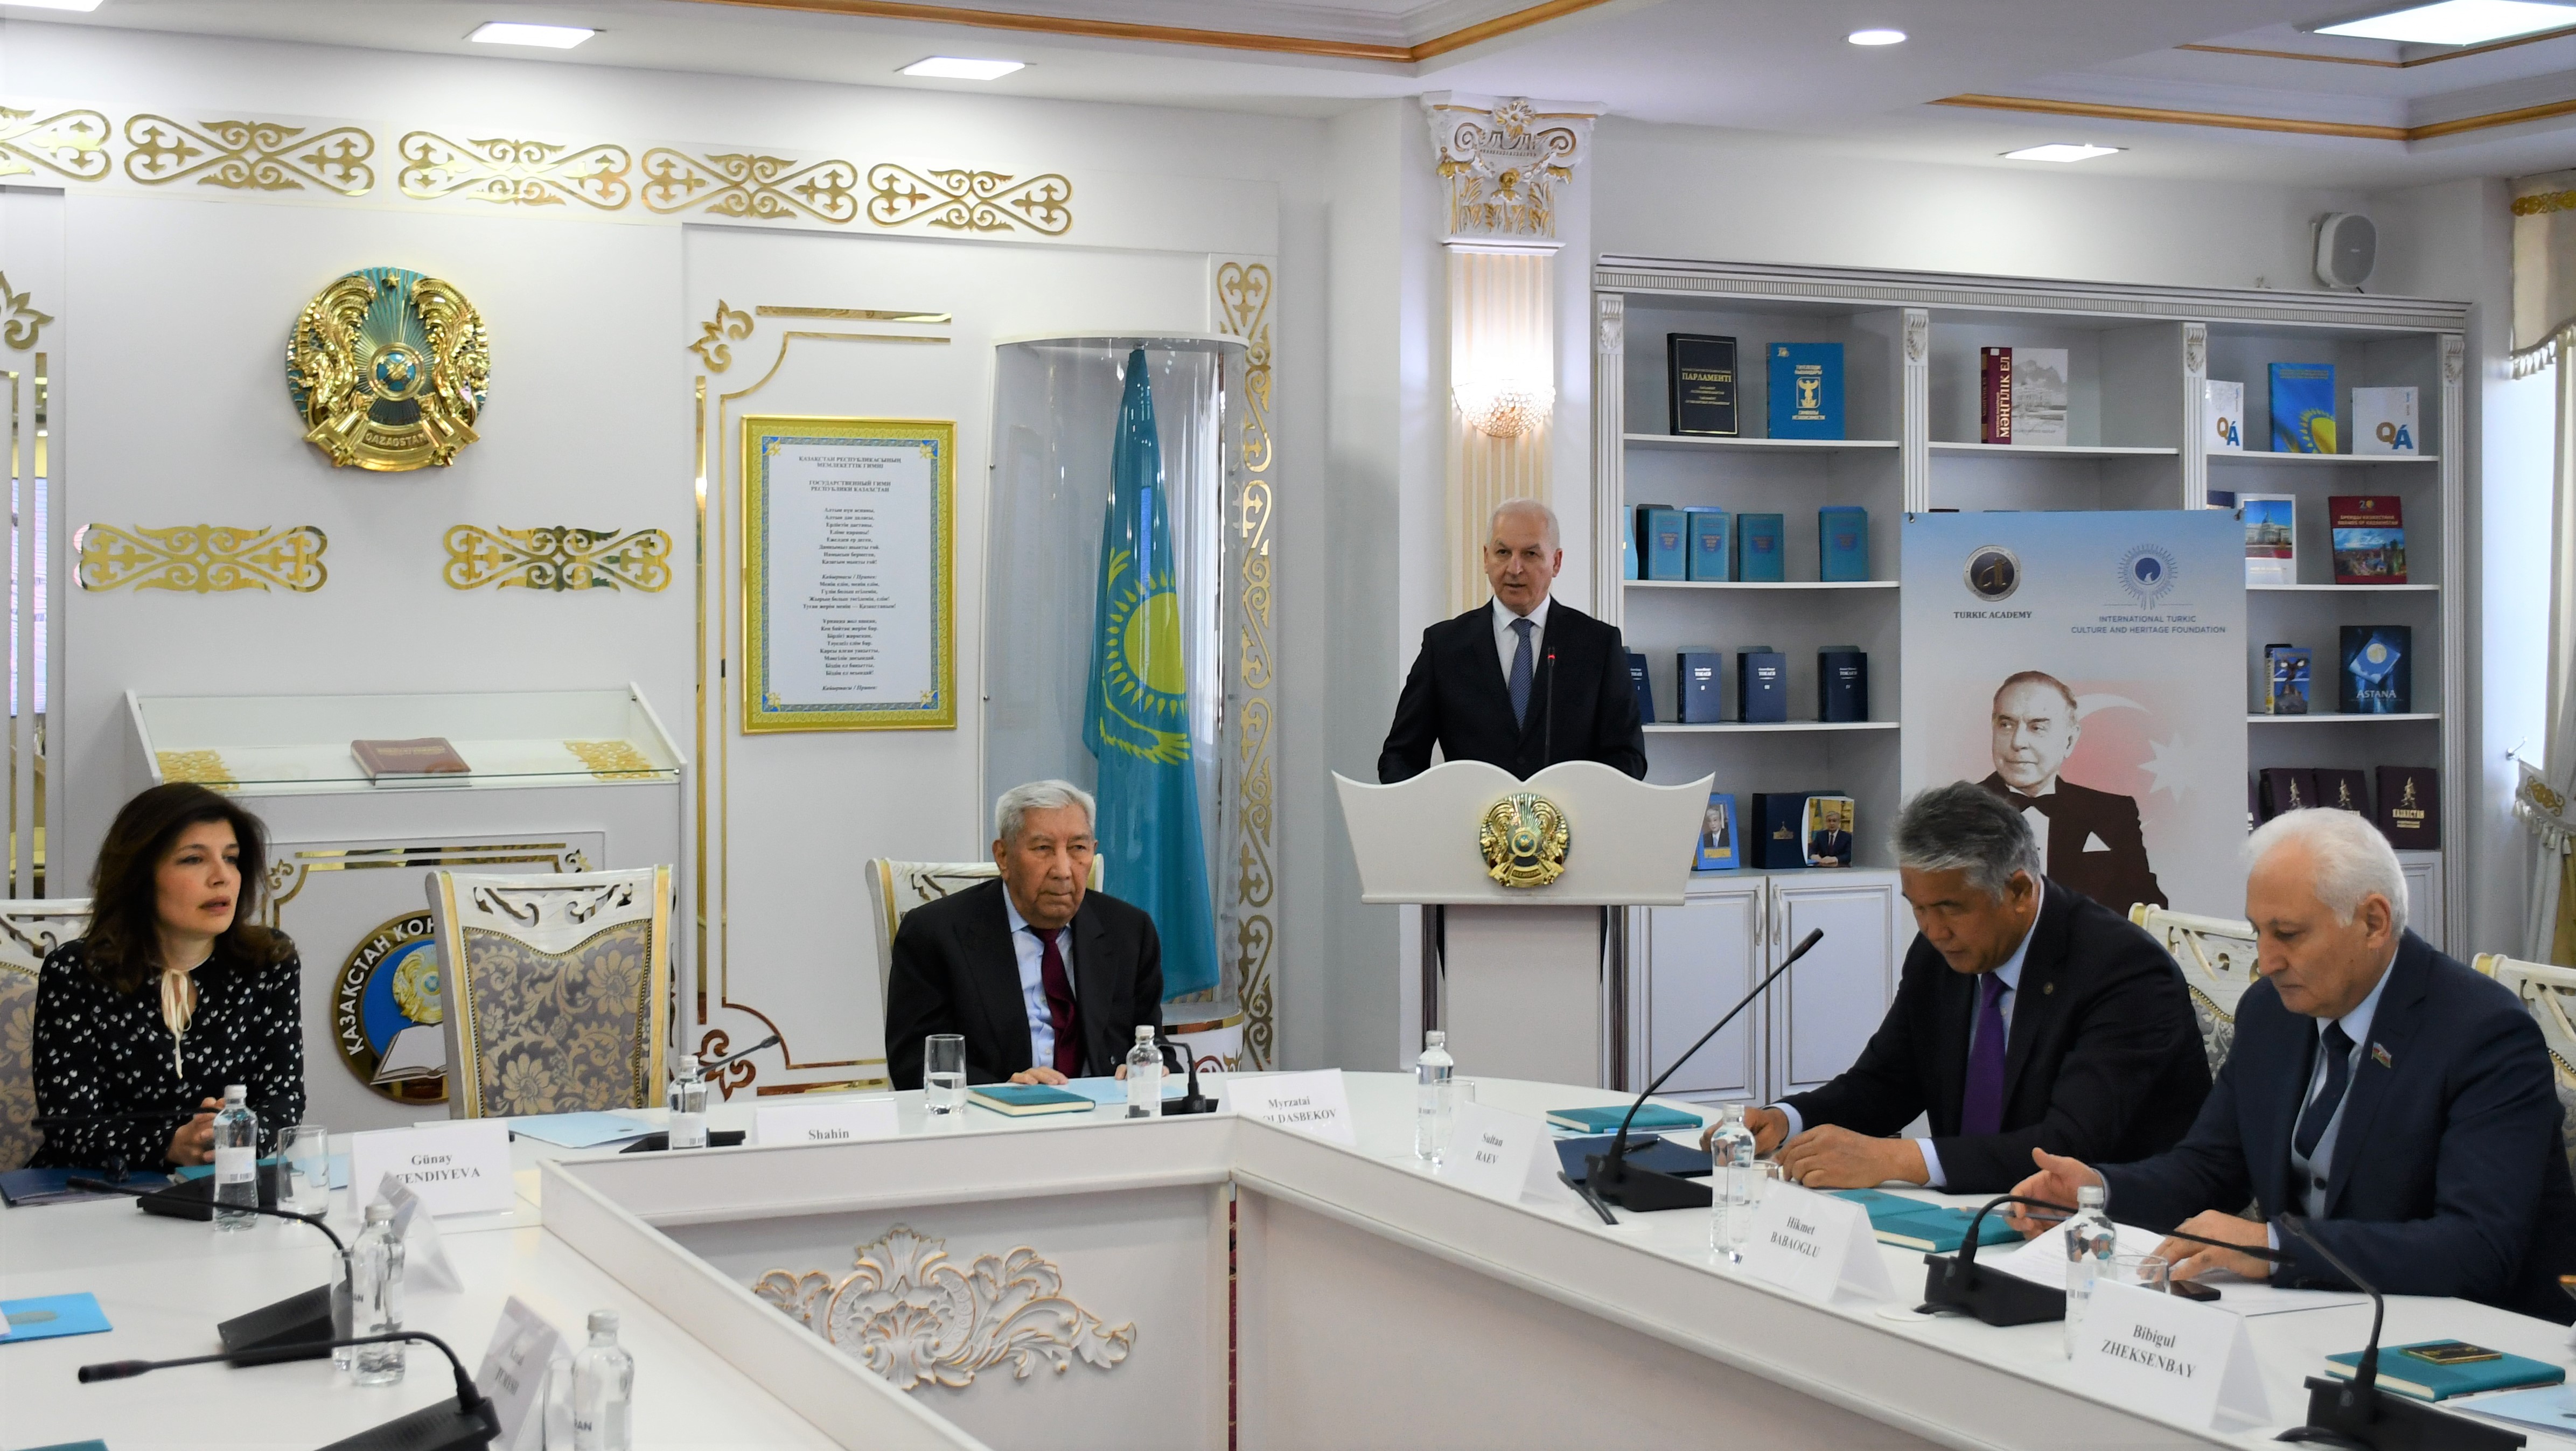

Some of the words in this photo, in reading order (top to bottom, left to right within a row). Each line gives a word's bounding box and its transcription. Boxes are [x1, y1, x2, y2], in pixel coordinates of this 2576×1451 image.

[2000, 356, 2010, 372] ЕЛ
[1682, 372, 1732, 382] ПАРЛАМЕНТІ
[2356, 689, 2397, 699] ASTANA
[1268, 1096, 1310, 1110] Myrzatai
[808, 1128, 849, 1140] Shahin
[1482, 1133, 1503, 1147] Sultan
[411, 1154, 452, 1165] Günay
[1475, 1150, 1498, 1164] RAEV
[396, 1167, 480, 1184] FENDIYEVA
[1786, 1216, 1815, 1236] Hikmet
[1770, 1231, 1820, 1258] BABAOGLU
[2133, 1324, 2176, 1348] Bibigul
[2101, 1339, 2196, 1378] ZHEKSENBAY
